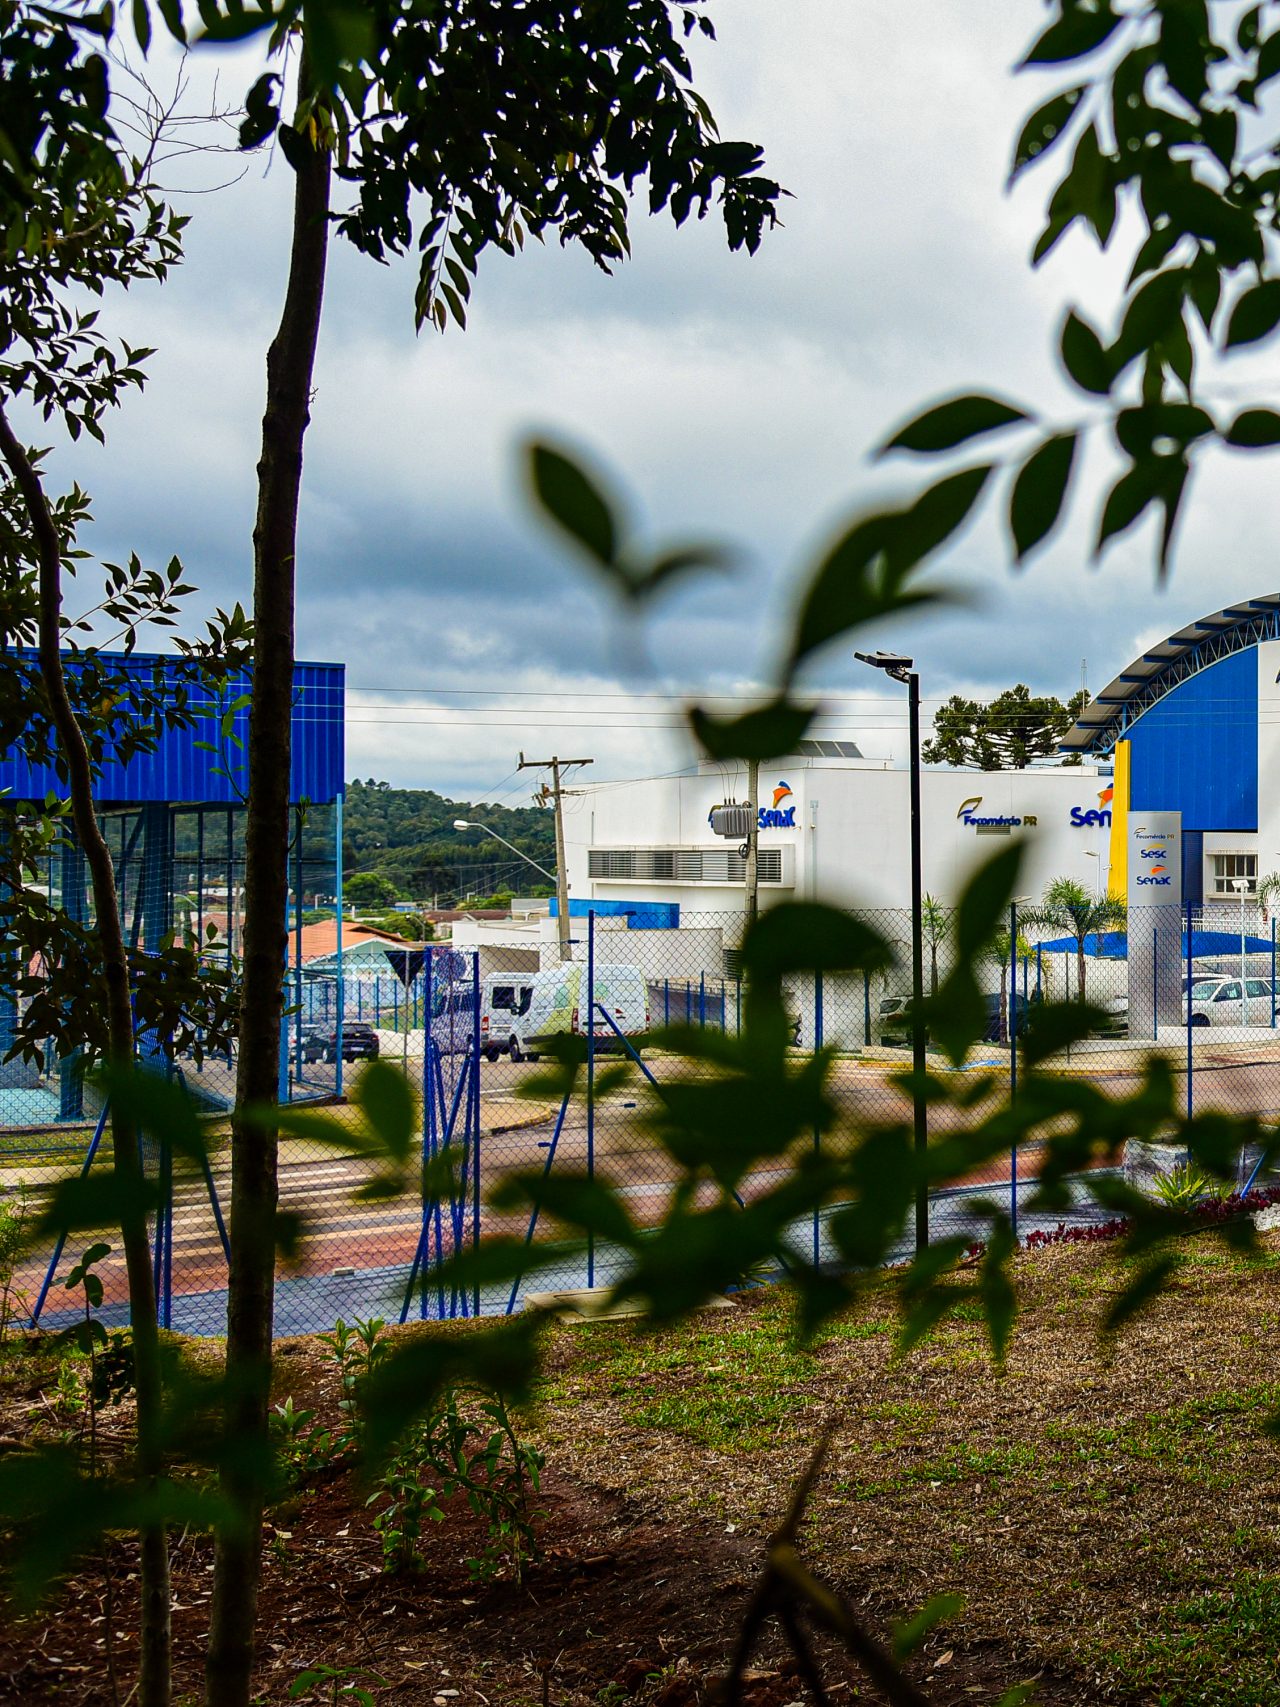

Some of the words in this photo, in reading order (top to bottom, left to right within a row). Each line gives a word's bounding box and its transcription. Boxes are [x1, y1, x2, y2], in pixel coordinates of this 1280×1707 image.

[757, 805, 796, 829] Senac
[964, 815, 1021, 826] Fecomércio
[1023, 815, 1038, 826] PR
[1070, 806, 1112, 827] Sen
[1140, 849, 1167, 859] Sesc
[1136, 875, 1171, 886] Senac
